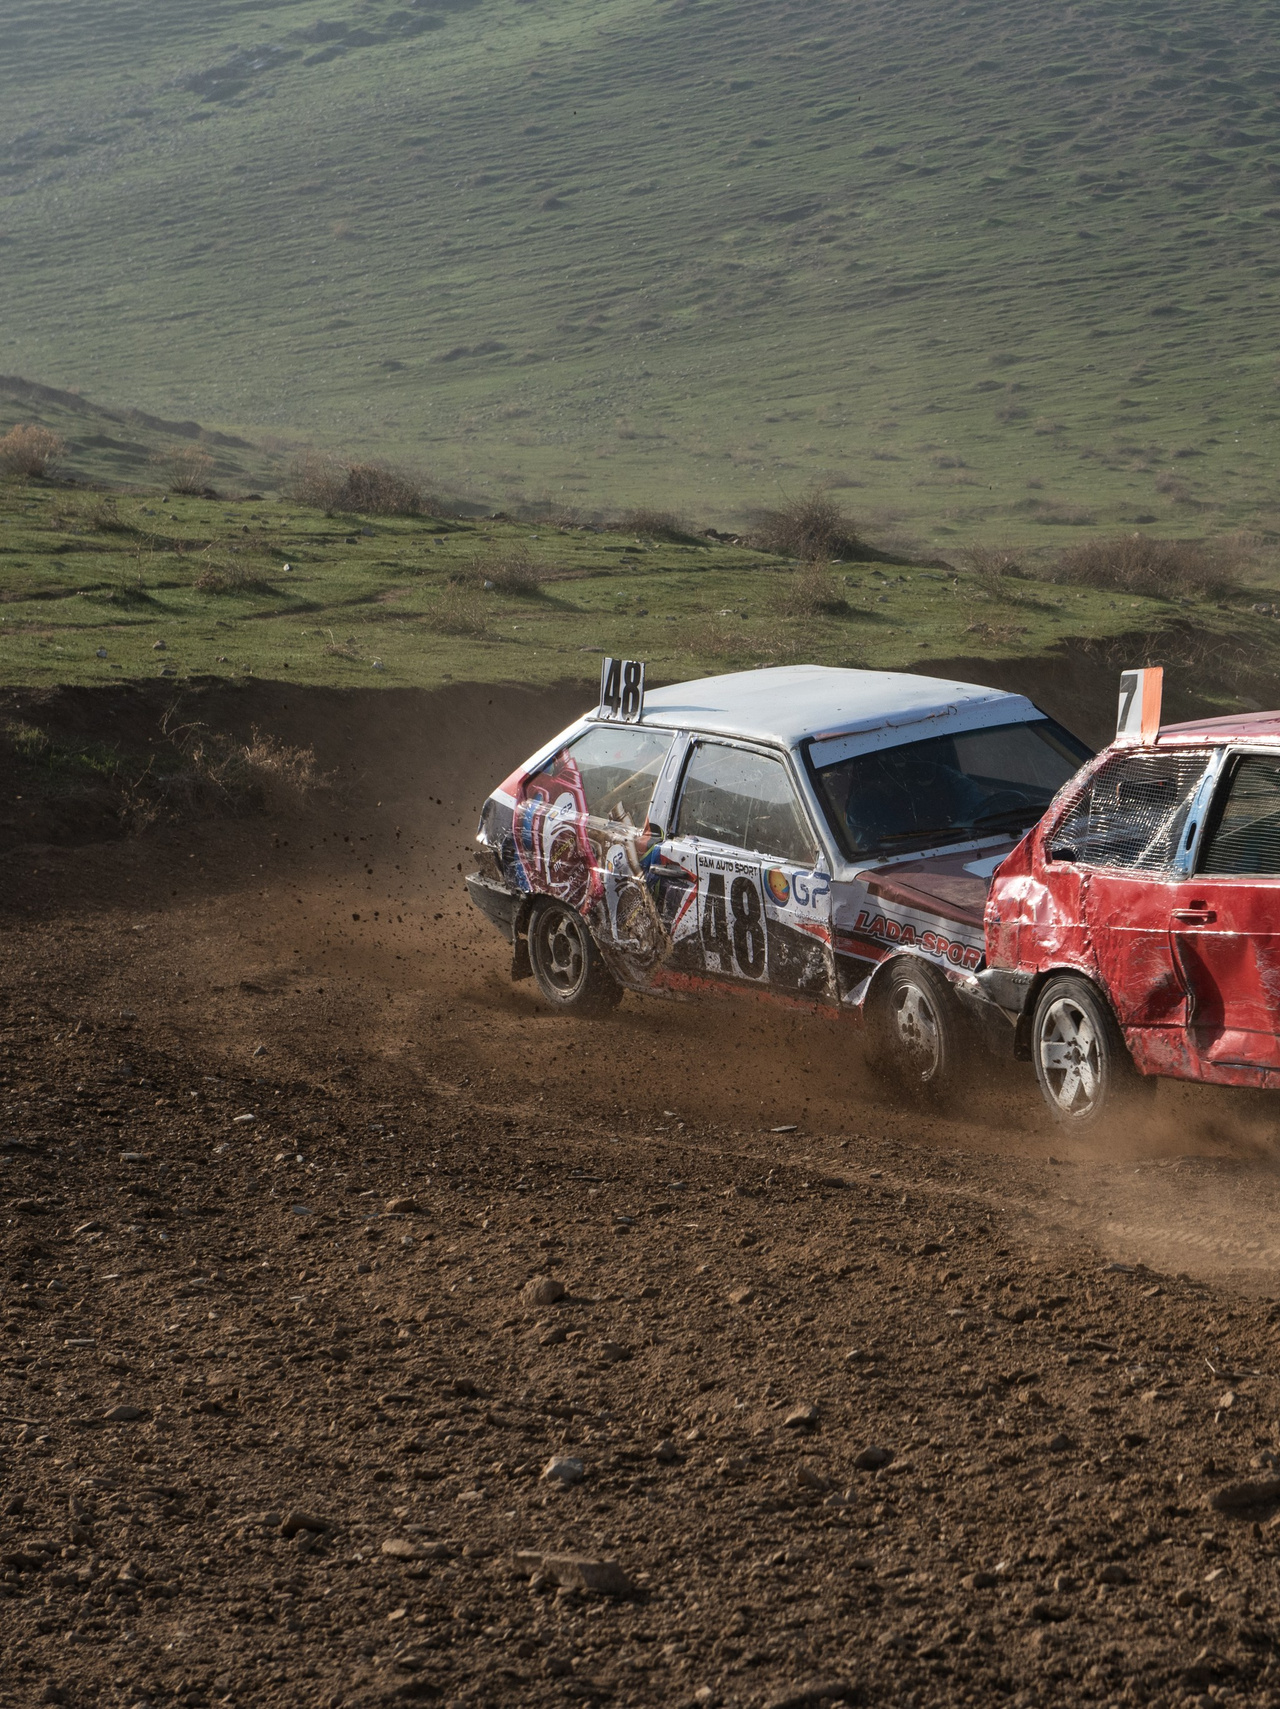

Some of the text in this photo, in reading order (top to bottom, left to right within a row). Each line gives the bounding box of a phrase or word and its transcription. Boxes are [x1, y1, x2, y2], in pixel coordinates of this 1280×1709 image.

[604, 659, 641, 720] 48
[1118, 674, 1138, 732] 7
[699, 857, 758, 876] SAM AUTO SPORT
[792, 871, 831, 908] GP
[702, 873, 766, 979] 48
[853, 910, 985, 970] LADA-SPOR
